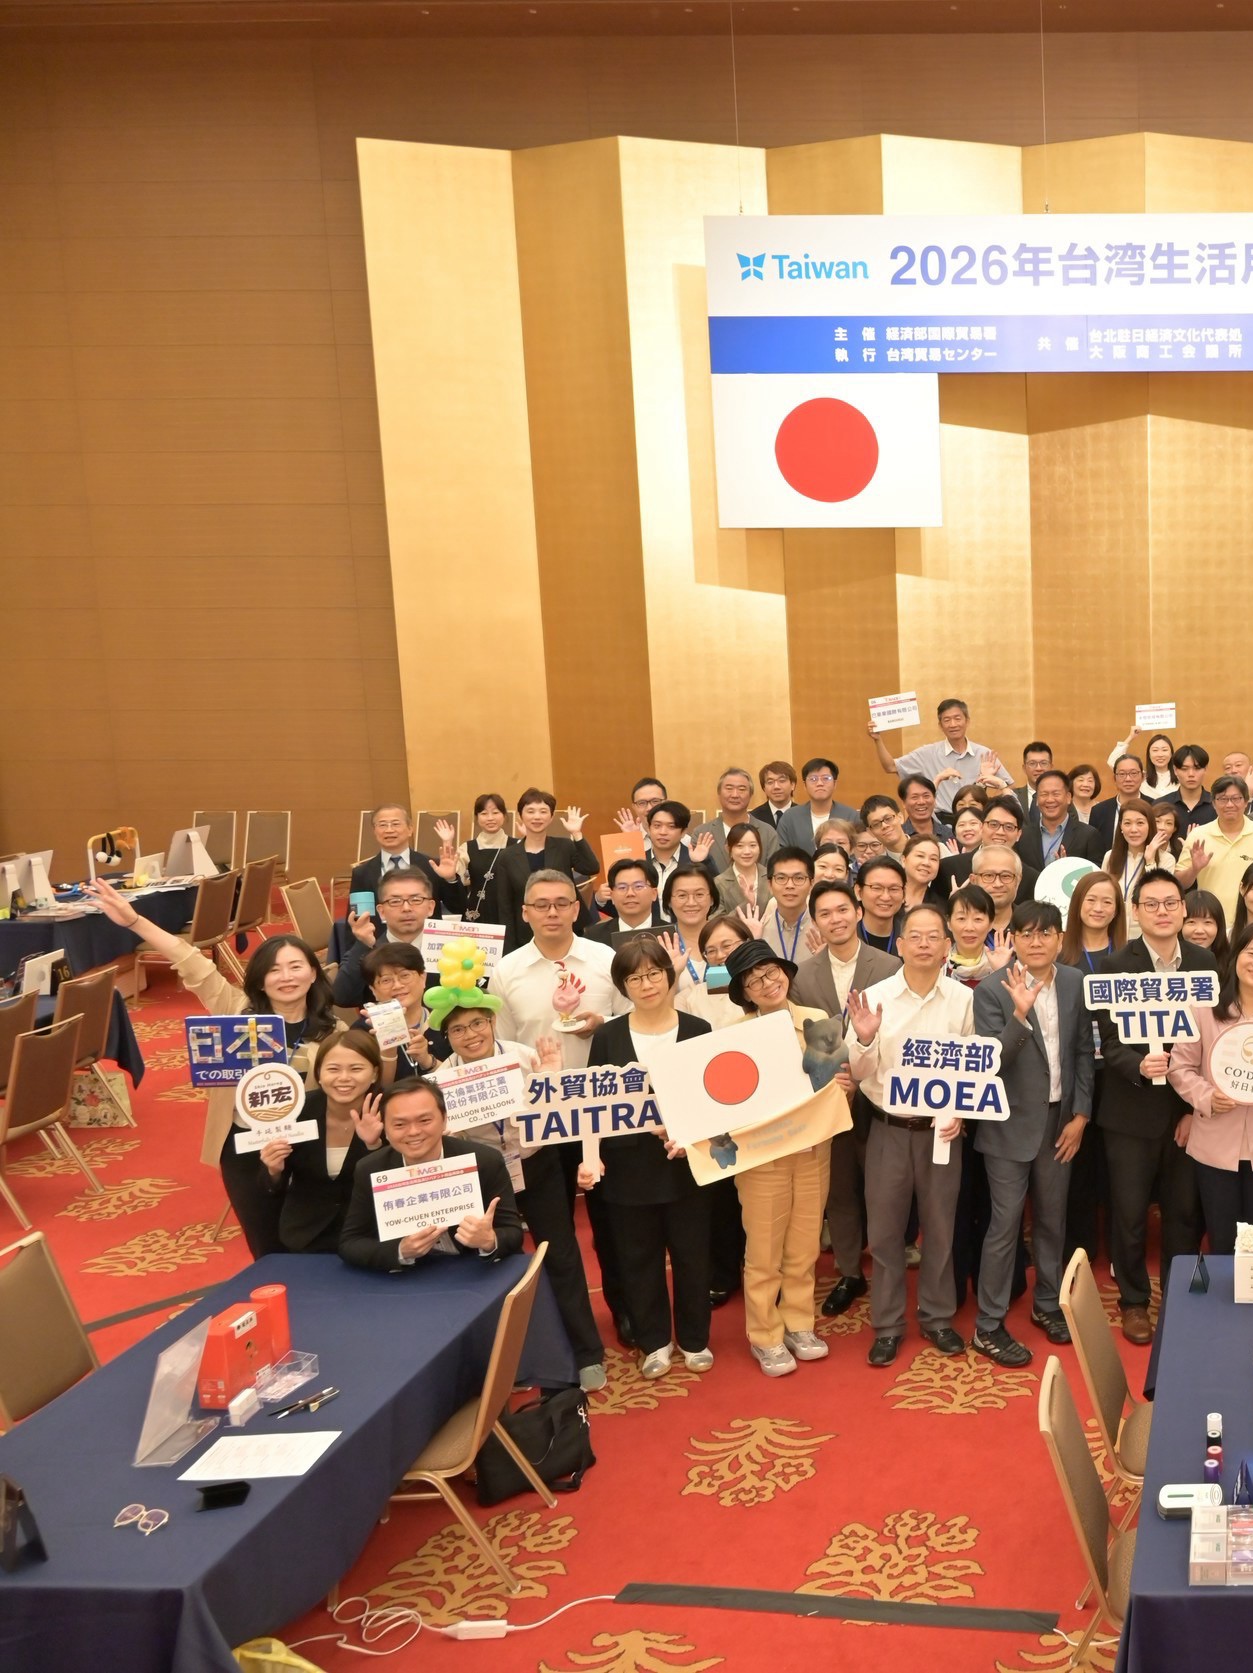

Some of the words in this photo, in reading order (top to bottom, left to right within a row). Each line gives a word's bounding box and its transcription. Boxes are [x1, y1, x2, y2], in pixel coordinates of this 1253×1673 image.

[771, 253, 869, 279] Taiwan
[887, 347, 997, 362] 台湾貿易センター
[1089, 976, 1214, 1004] 國際貿易署
[1116, 1010, 1194, 1038] TITA
[189, 1018, 284, 1067] 日本
[901, 1038, 995, 1073] 經濟部
[248, 1086, 292, 1108] 新宏
[446, 1085, 509, 1110] 股份有限公司
[528, 1067, 648, 1105] 外貿協會
[889, 1076, 1002, 1114] MOEA
[516, 1099, 663, 1142] TAITRA
[376, 1175, 388, 1184] 69
[385, 1213, 430, 1227] YOW-CHUEN
[430, 1202, 475, 1217] ENTERPRISE
